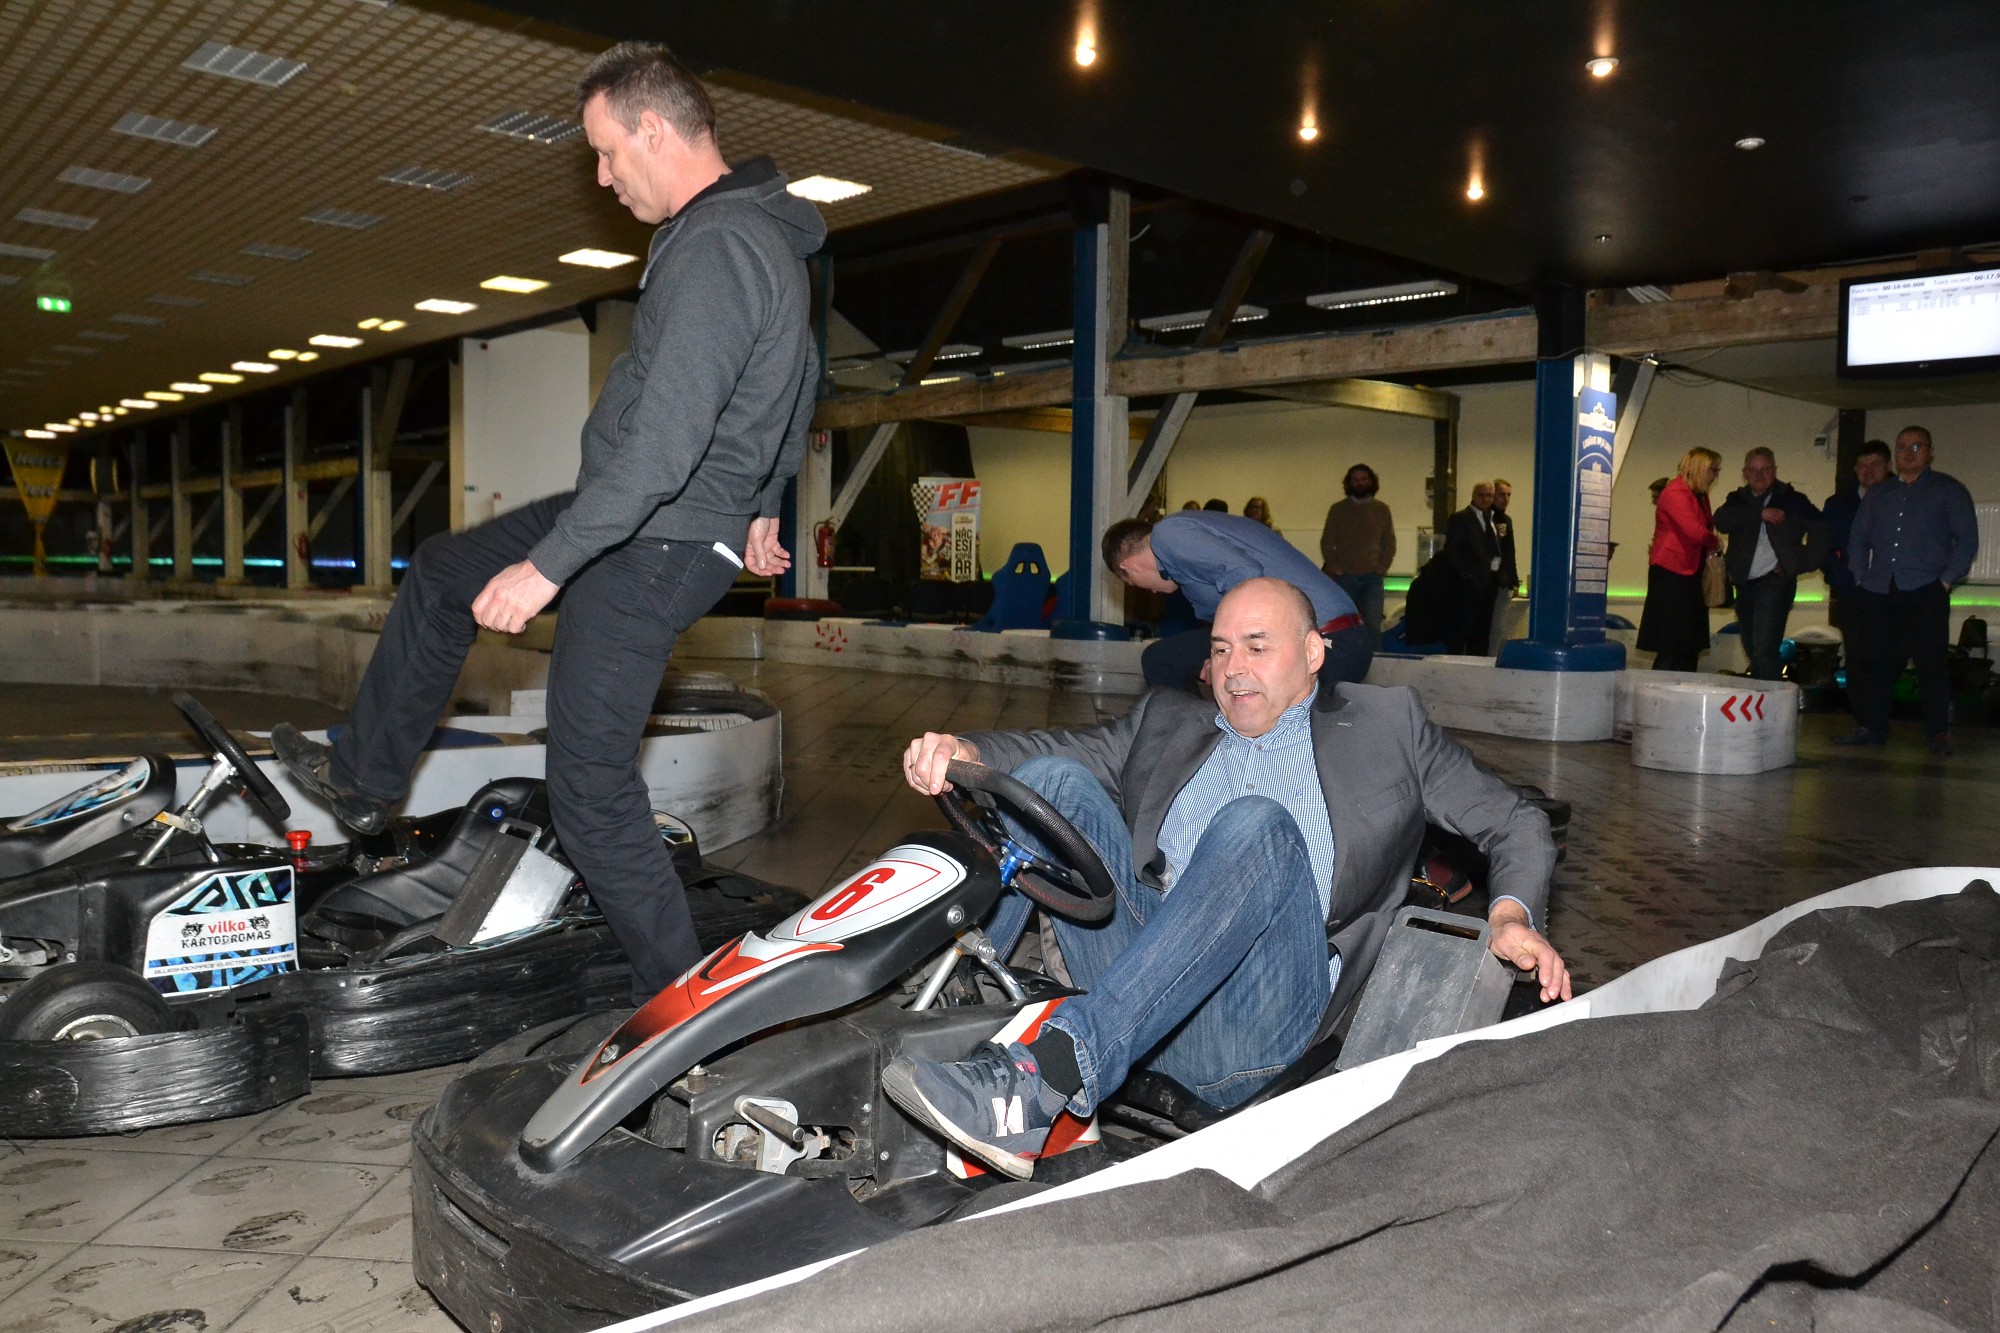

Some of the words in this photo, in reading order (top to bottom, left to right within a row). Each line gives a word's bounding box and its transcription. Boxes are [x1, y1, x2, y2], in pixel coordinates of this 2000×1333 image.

[955, 561, 972, 575] AR
[810, 867, 896, 920] 6
[207, 919, 247, 934] vilko
[181, 930, 271, 949] KARTODROMAS
